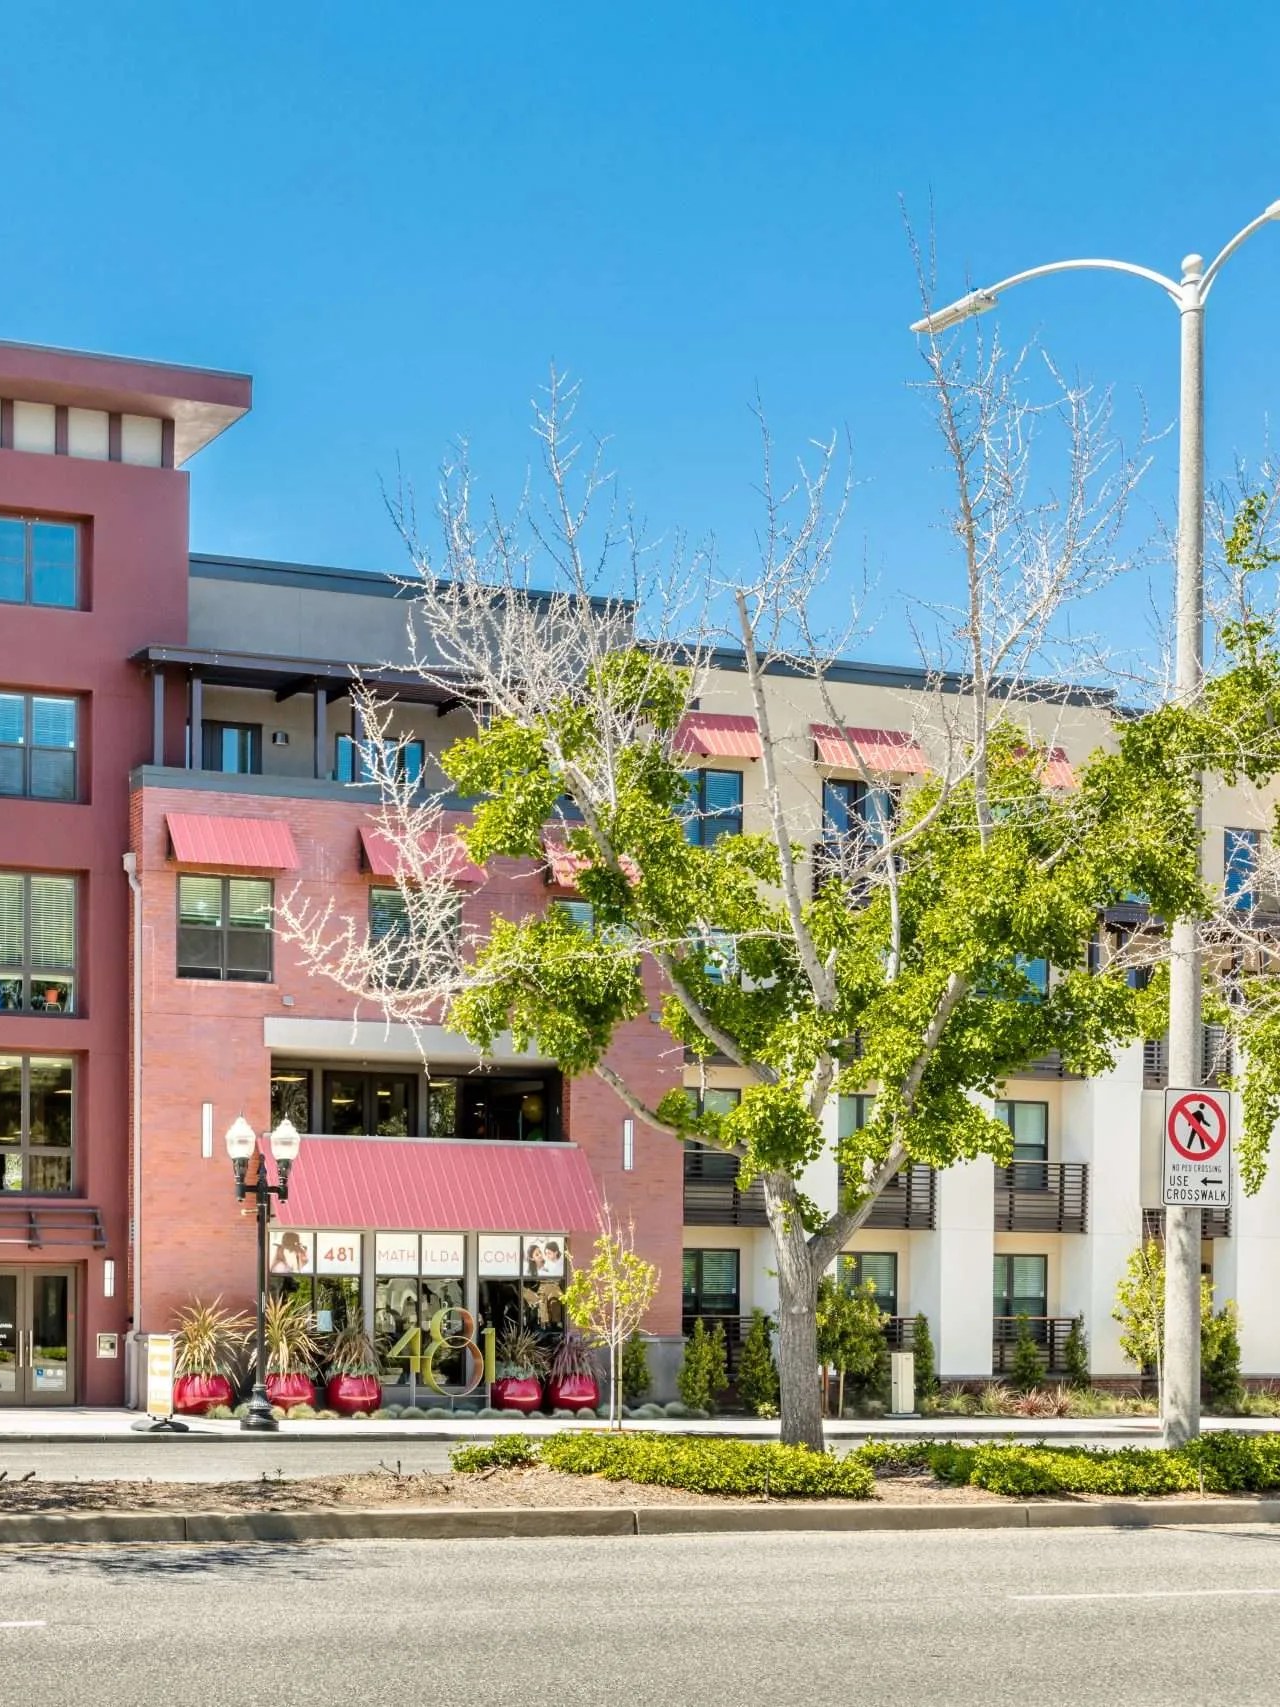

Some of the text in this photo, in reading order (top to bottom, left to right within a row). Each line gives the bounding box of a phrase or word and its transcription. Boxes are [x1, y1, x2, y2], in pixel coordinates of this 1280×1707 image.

[1169, 1175, 1189, 1187] USE
[1166, 1188, 1226, 1201] CROSSWALK
[323, 1247, 354, 1262] 481
[387, 1306, 495, 1397] 481
